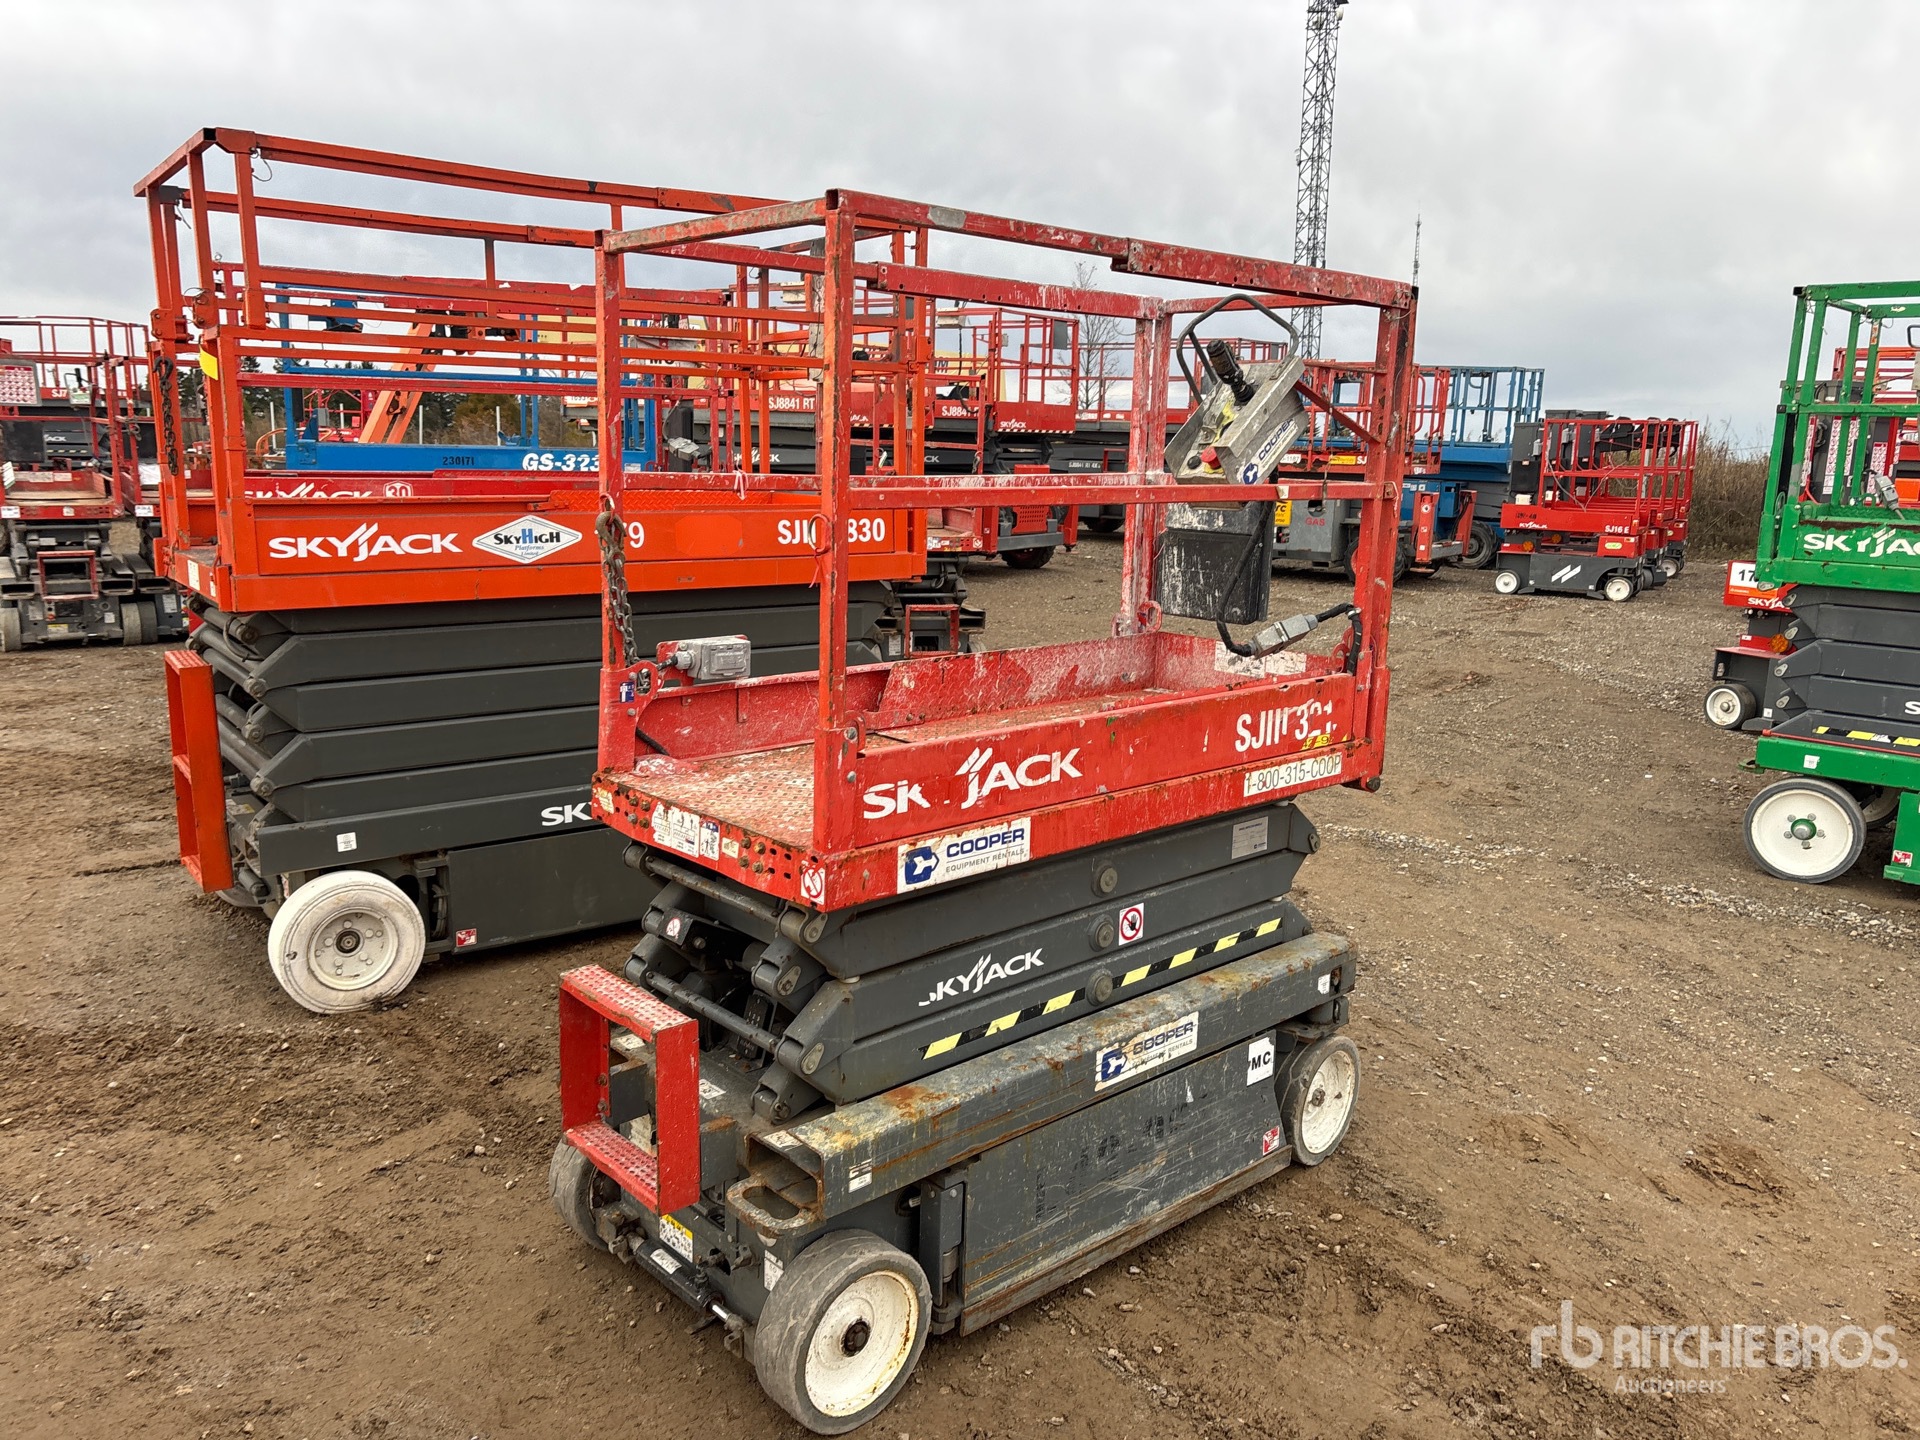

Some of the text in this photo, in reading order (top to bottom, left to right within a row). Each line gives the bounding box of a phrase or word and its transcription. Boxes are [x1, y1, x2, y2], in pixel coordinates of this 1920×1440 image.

[768, 397, 815, 410] SJ8841 RT
[442, 456, 475, 466] 230171
[1305, 517, 1325, 526] GAS
[1604, 524, 1623, 533] SJ16
[268, 522, 463, 562] SKYJACK
[514, 544, 545, 552] Platforms
[863, 747, 1083, 819] SKJACK
[946, 827, 1025, 858] COOPER
[945, 848, 1026, 873] EQUIPMENT RENTALS
[1251, 1051, 1271, 1071] MC
